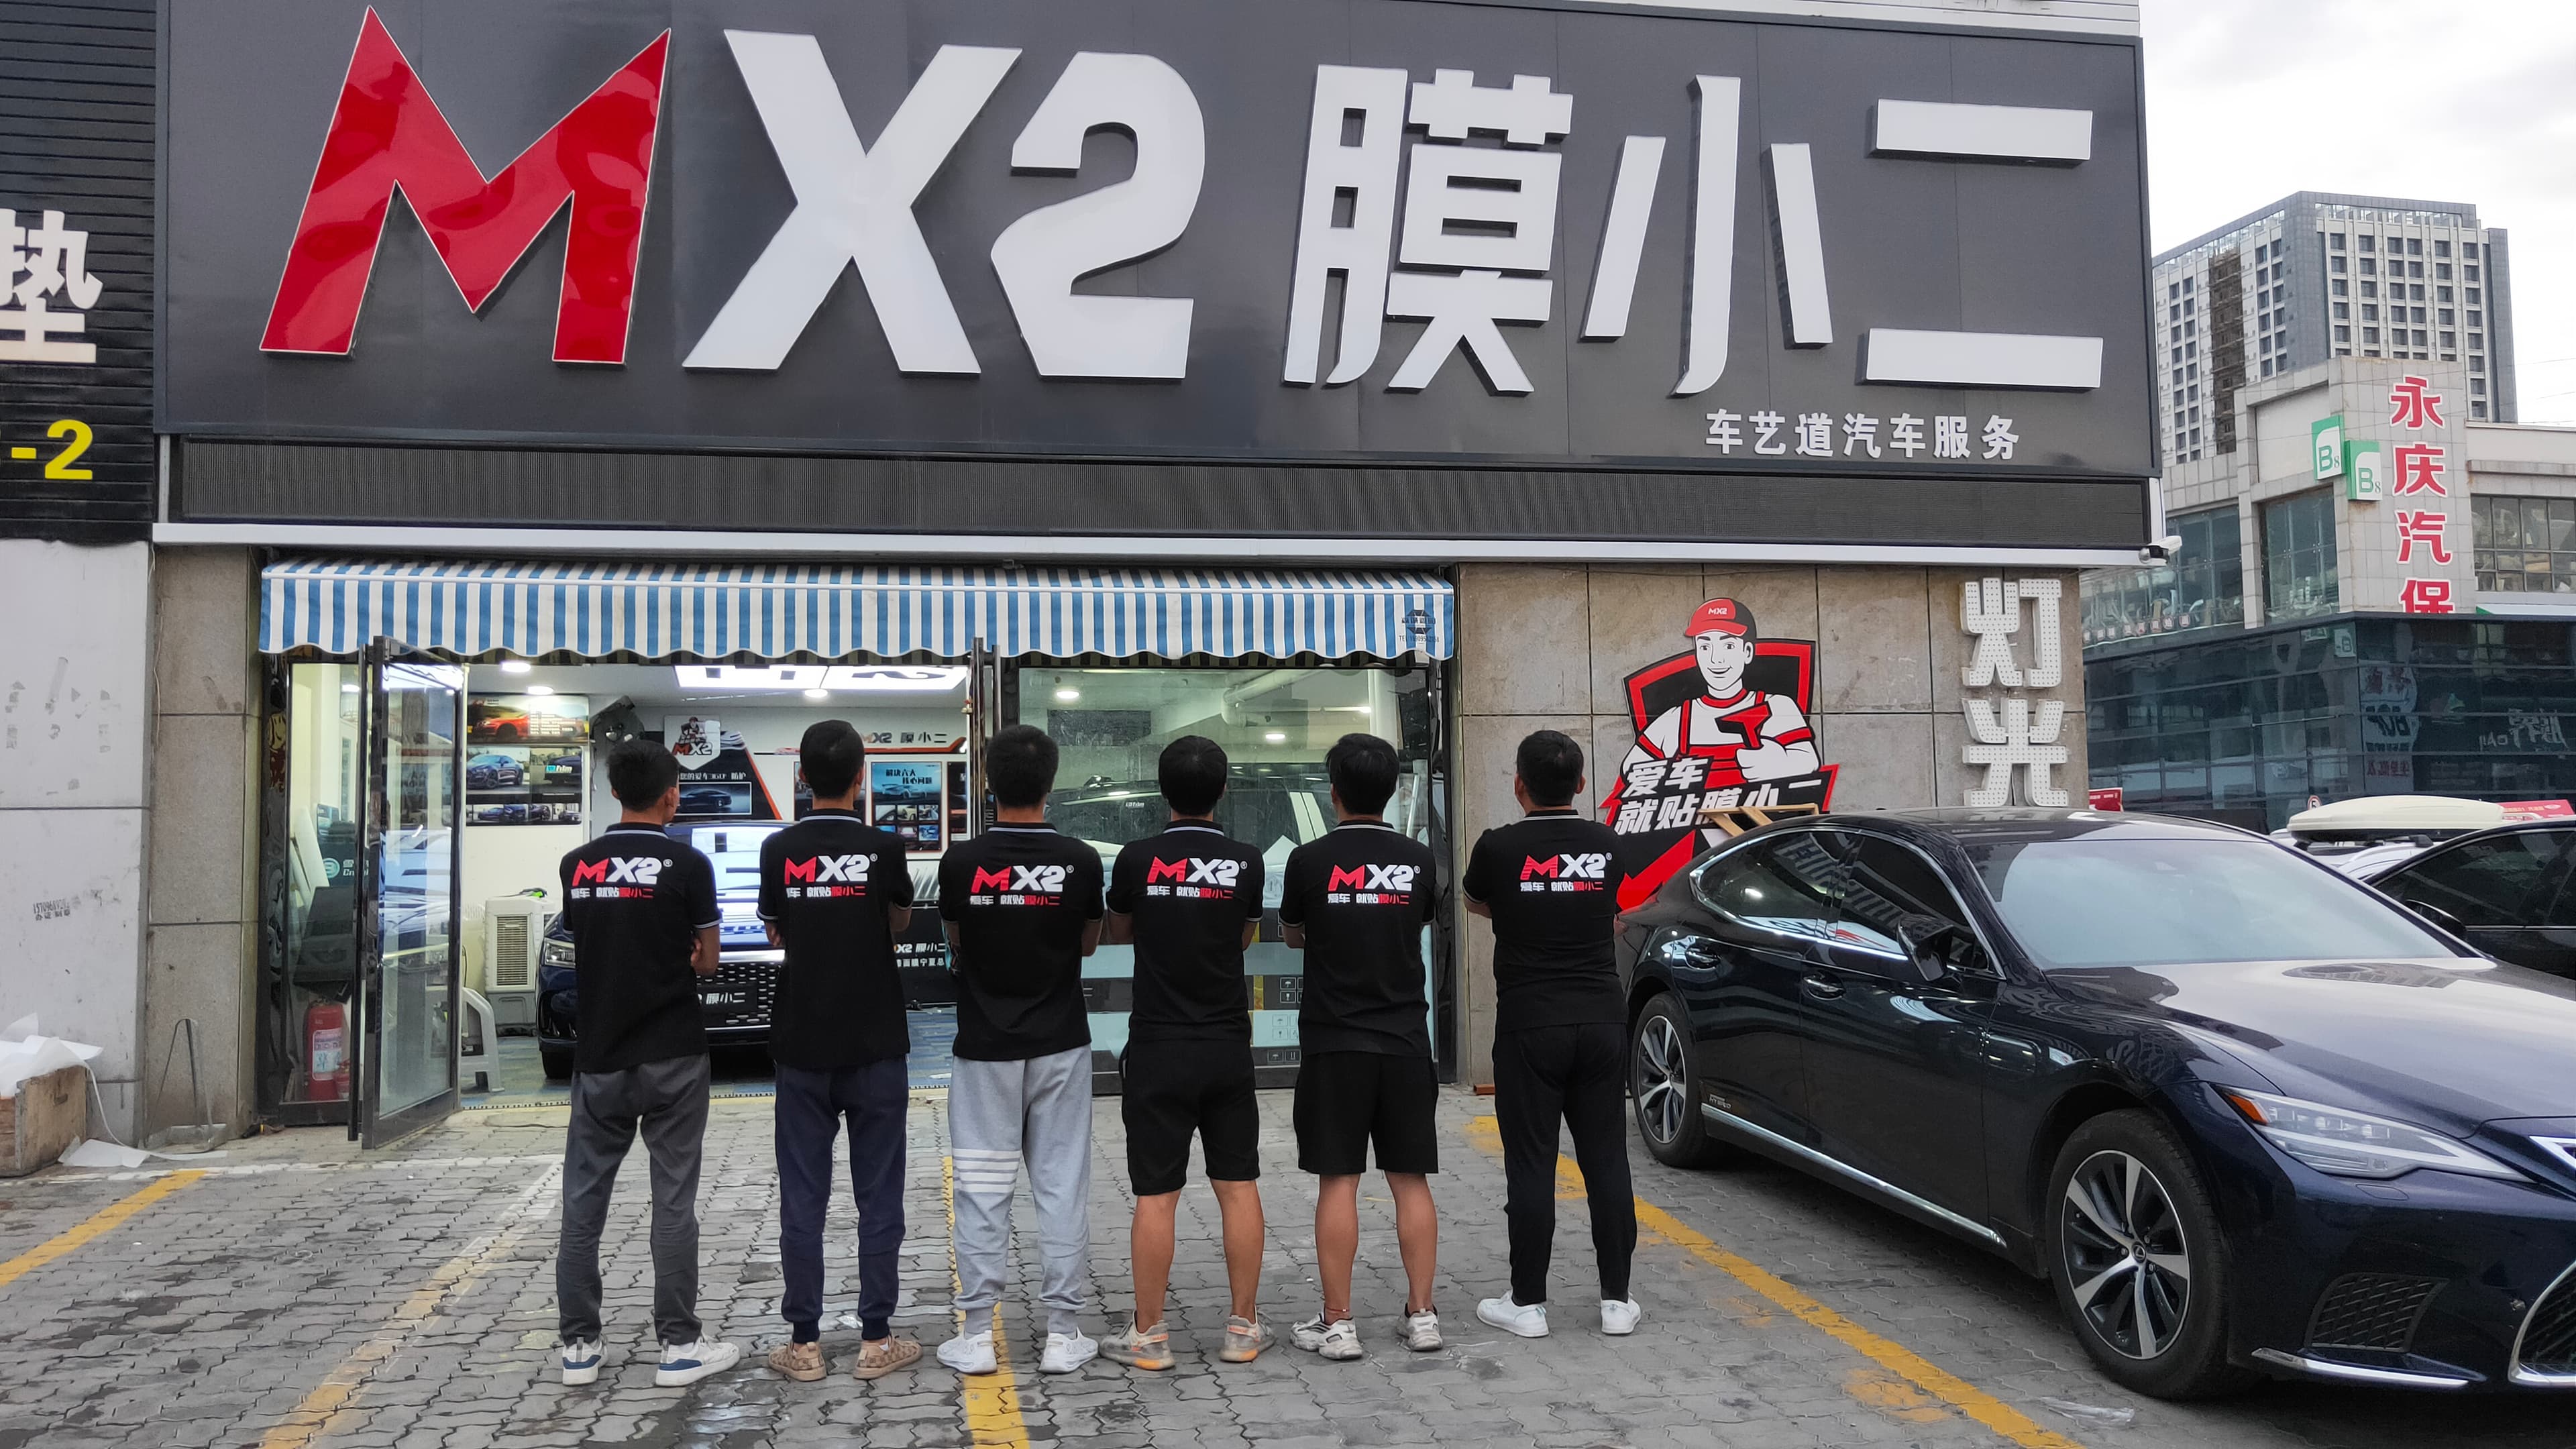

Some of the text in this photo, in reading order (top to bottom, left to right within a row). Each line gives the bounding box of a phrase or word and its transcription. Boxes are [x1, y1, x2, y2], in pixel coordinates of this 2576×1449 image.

[260, 5, 2104, 396] MX2 膜小二
[0, 209, 103, 363] 垫
[0, 419, 93, 480] -2
[1705, 409, 2020, 460] 车艺道汽车服务
[1708, 607, 1727, 615] MX2
[1962, 577, 2069, 807] 灯光
[671, 741, 713, 756] MX2
[1621, 757, 1709, 798] 爱车
[706, 991, 746, 1005] 膜小二
